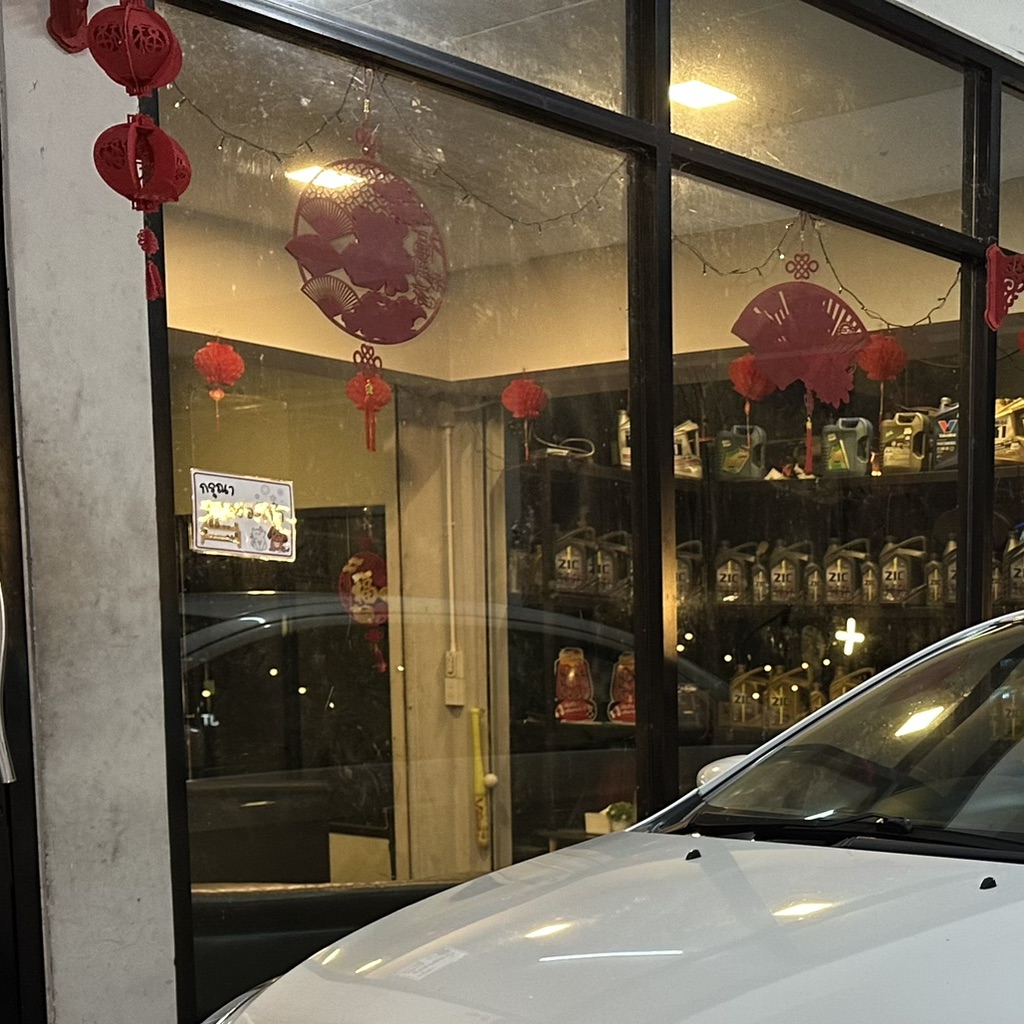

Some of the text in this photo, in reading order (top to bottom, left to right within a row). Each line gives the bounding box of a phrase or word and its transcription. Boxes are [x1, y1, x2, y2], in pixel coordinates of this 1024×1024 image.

[558, 559, 580, 570] ZIC
[720, 573, 739, 583] ZIC
[774, 573, 793, 583] ZIC
[828, 572, 848, 582] ZIC
[885, 571, 904, 581] ZIC
